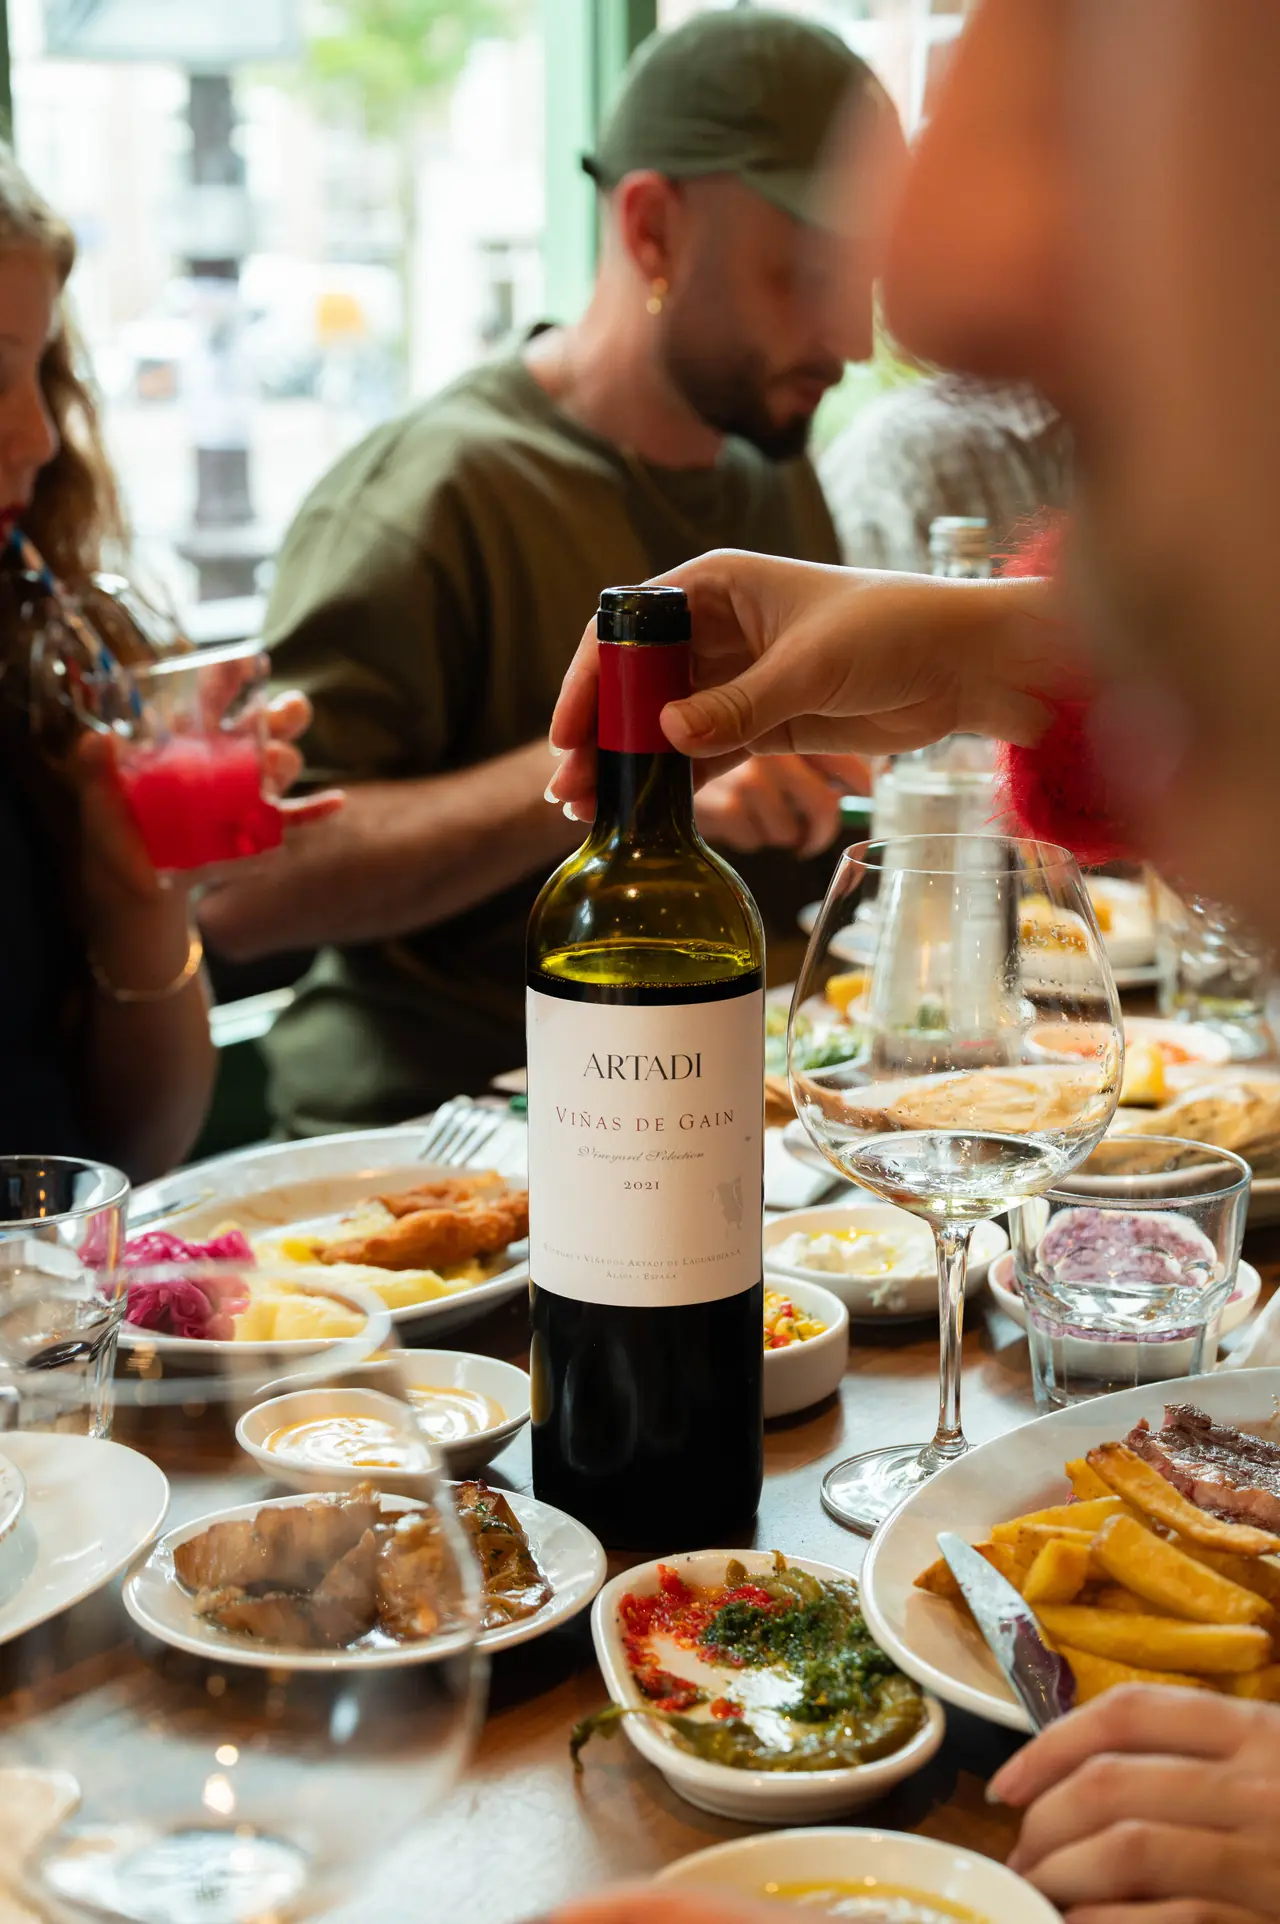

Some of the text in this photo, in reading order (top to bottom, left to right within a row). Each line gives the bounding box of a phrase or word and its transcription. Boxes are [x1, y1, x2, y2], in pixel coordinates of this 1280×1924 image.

[583, 1052, 703, 1081] ARTADI
[555, 1105, 735, 1132] VIÑAS DE GAIN
[577, 1145, 644, 1164] Vineyard
[623, 1180, 661, 1191] 2021
